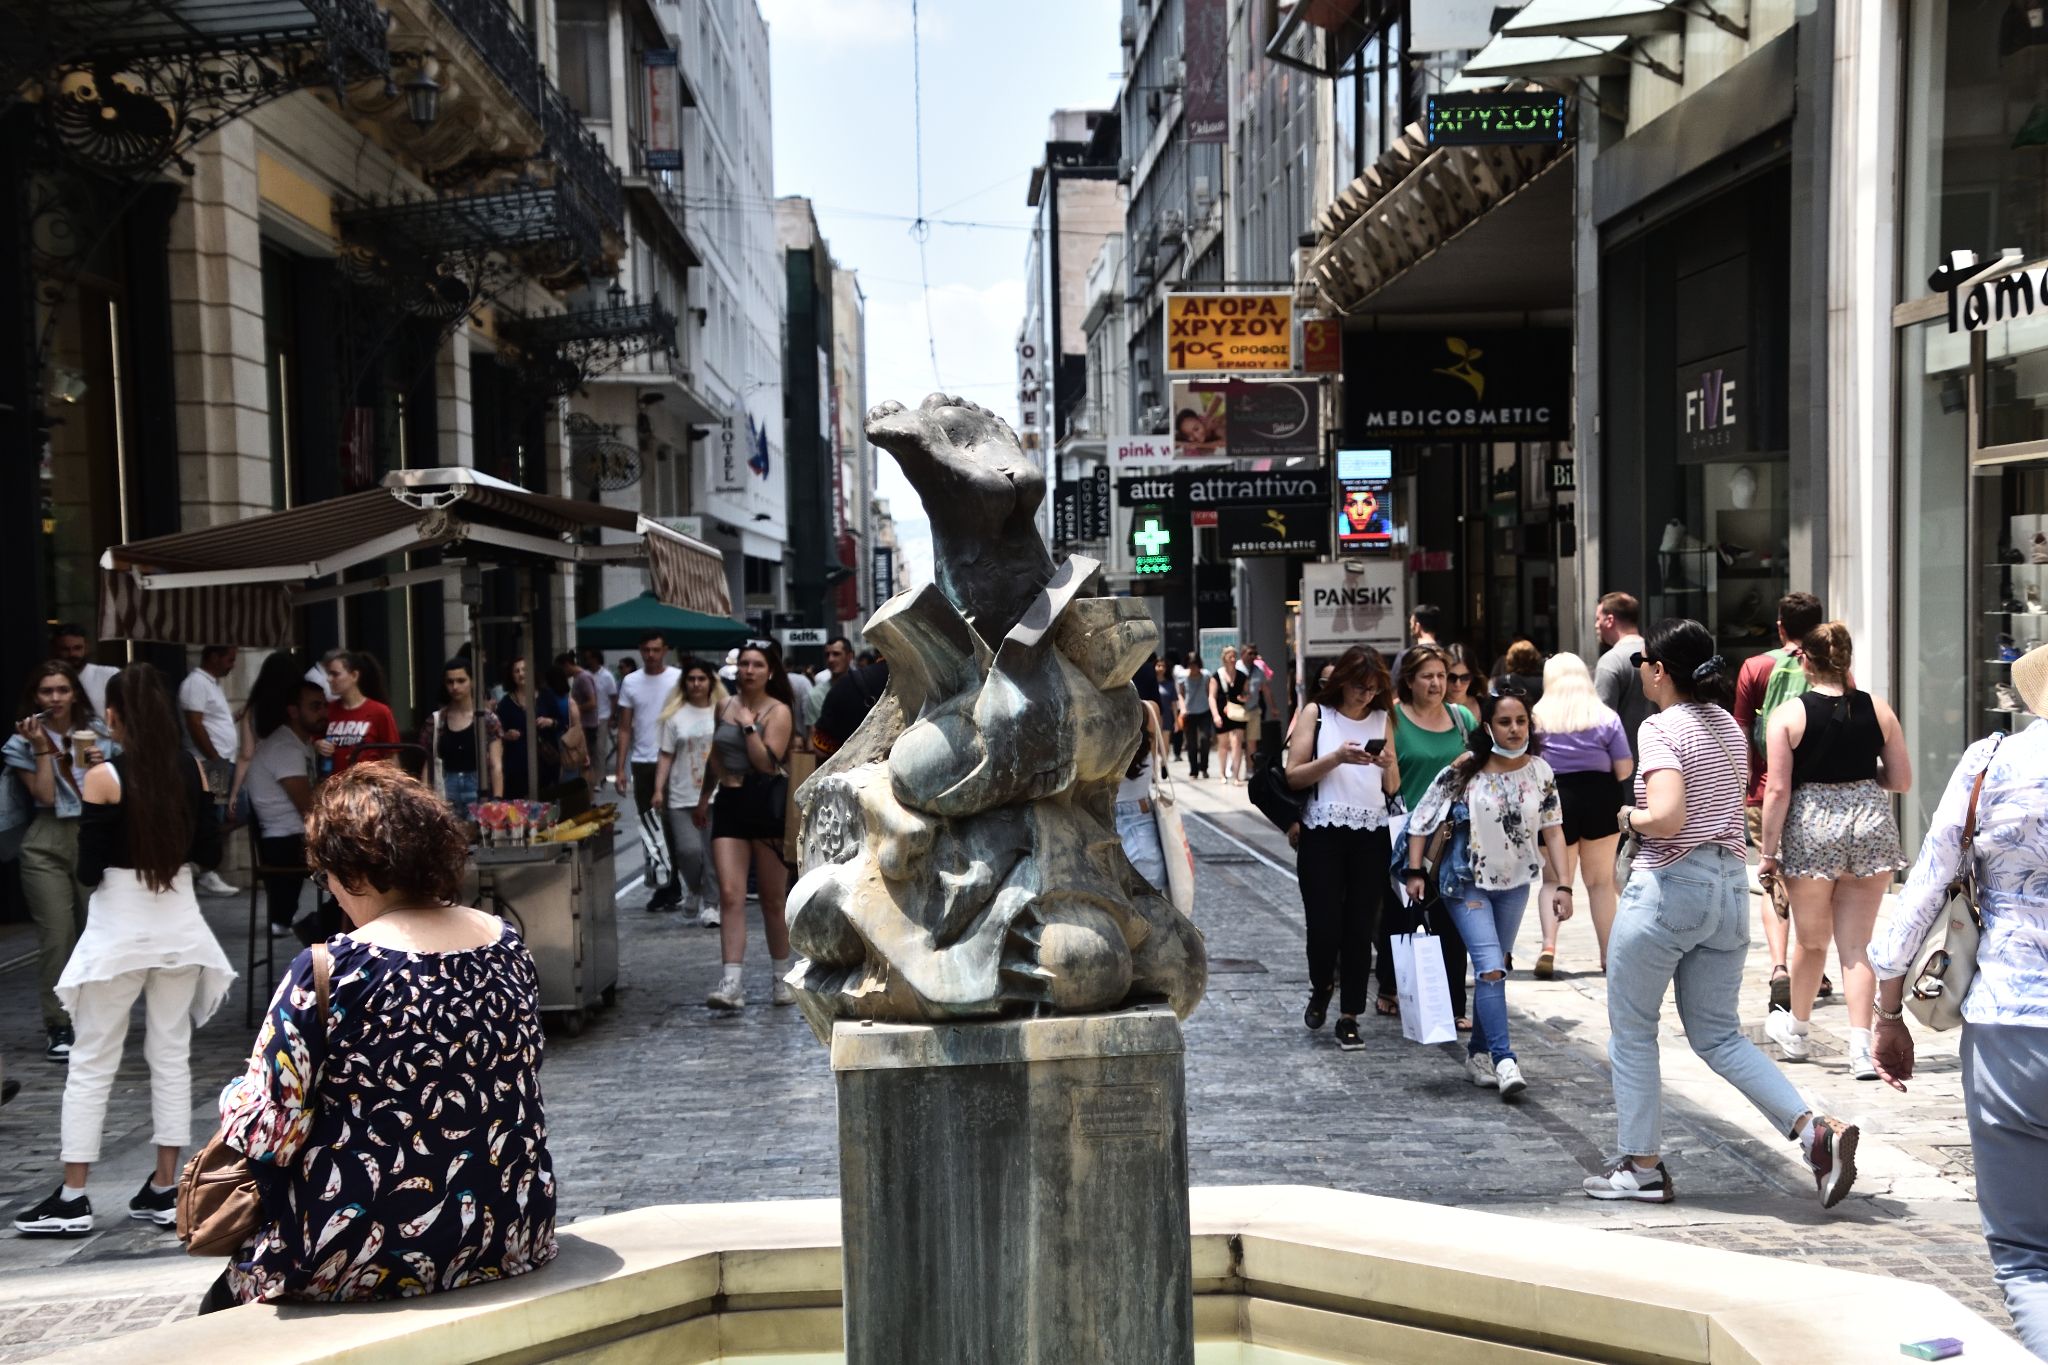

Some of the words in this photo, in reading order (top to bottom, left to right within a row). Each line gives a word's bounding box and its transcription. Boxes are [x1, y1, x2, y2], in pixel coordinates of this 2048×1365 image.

[1435, 106, 1555, 131] ΧΡΥΣΟΥ
[1182, 299, 1277, 316] ΑΓΟΡΑ
[1171, 318, 1288, 336] ΧΡΥΣΟΥ
[1170, 340, 1223, 369] 1ος
[1229, 344, 1288, 354] ΟΡΟΦΟΣ
[1217, 359, 1266, 369] ΕΡΜΟΥ
[1273, 360, 1288, 369] 14
[1366, 407, 1550, 427] MEDICOSMETIC
[721, 416, 735, 481] HOTEL
[1118, 442, 1154, 460] pink
[1189, 474, 1316, 501] attrattivo
[1082, 479, 1094, 539] MANGO
[1096, 468, 1109, 534] MANGO
[1232, 540, 1317, 550] MEDICOSMETIC
[326, 720, 371, 736] EARN
